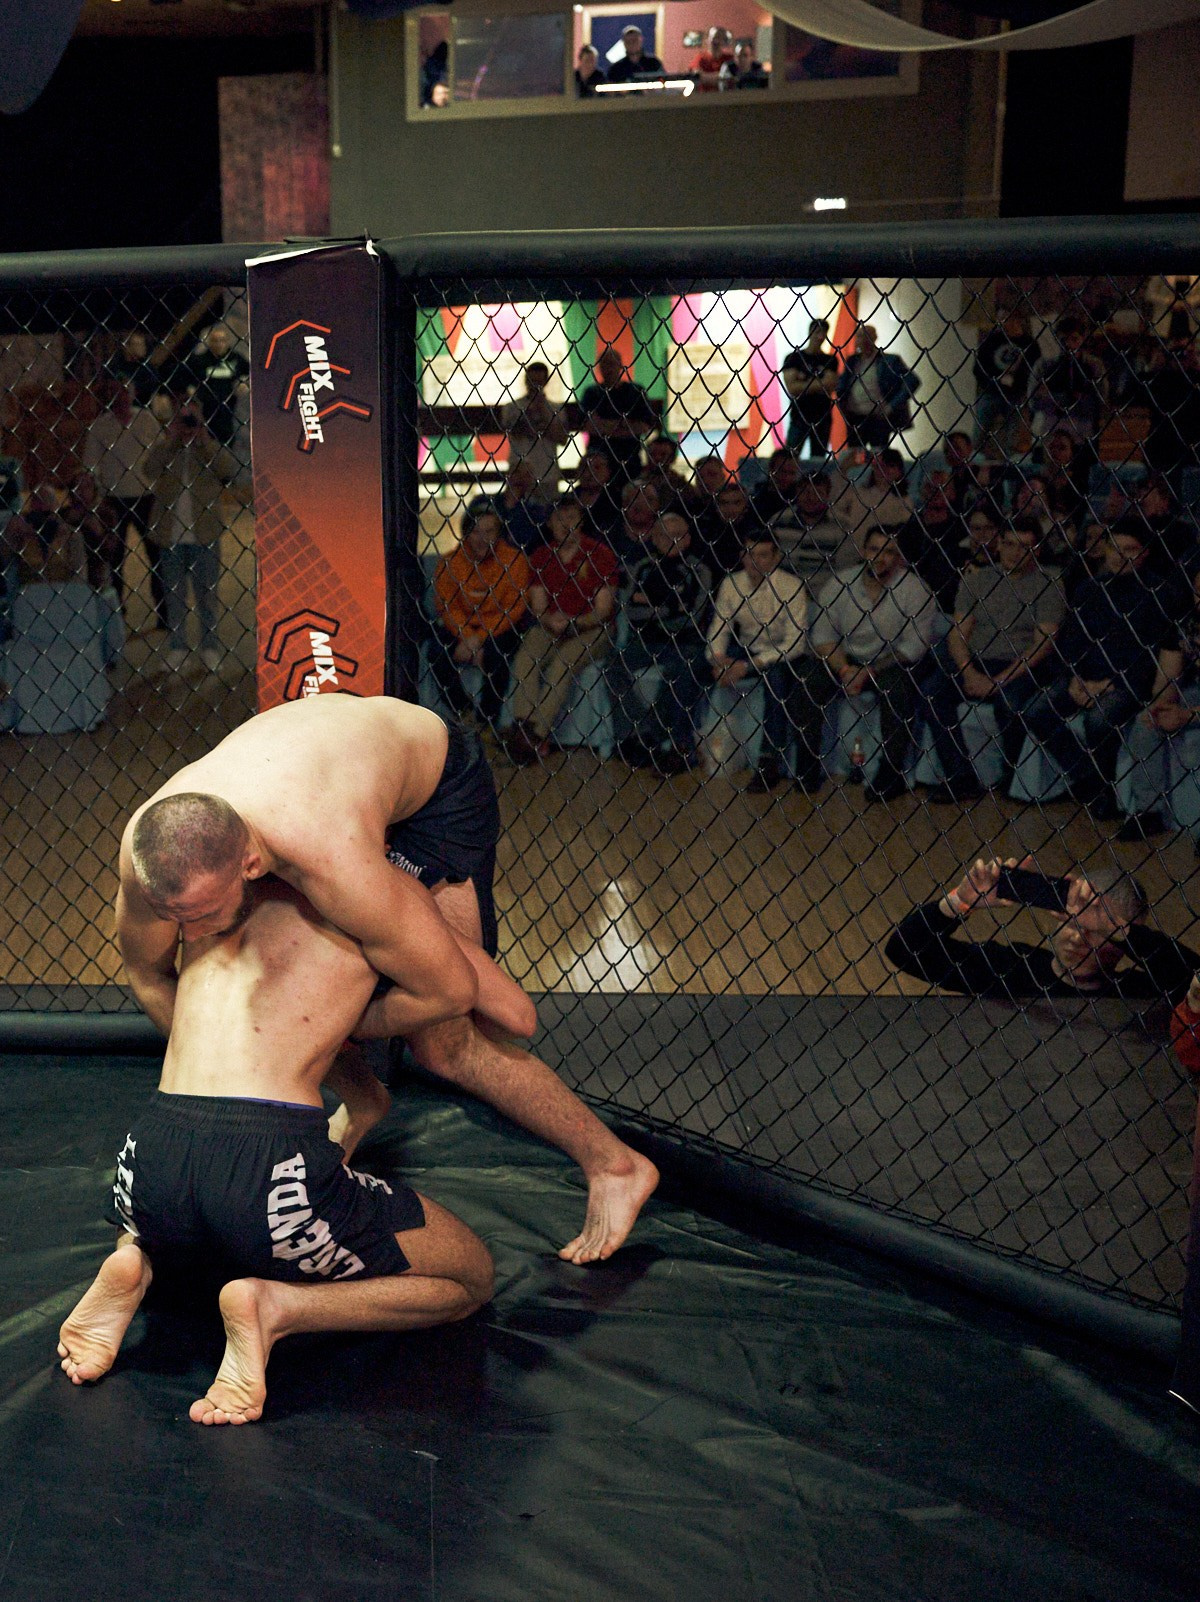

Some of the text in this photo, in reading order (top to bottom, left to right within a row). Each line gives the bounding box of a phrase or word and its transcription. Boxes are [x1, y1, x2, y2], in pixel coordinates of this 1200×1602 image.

[303, 335, 335, 392] MIX
[299, 382, 324, 443] FIGHT
[309, 631, 339, 685] MIX
